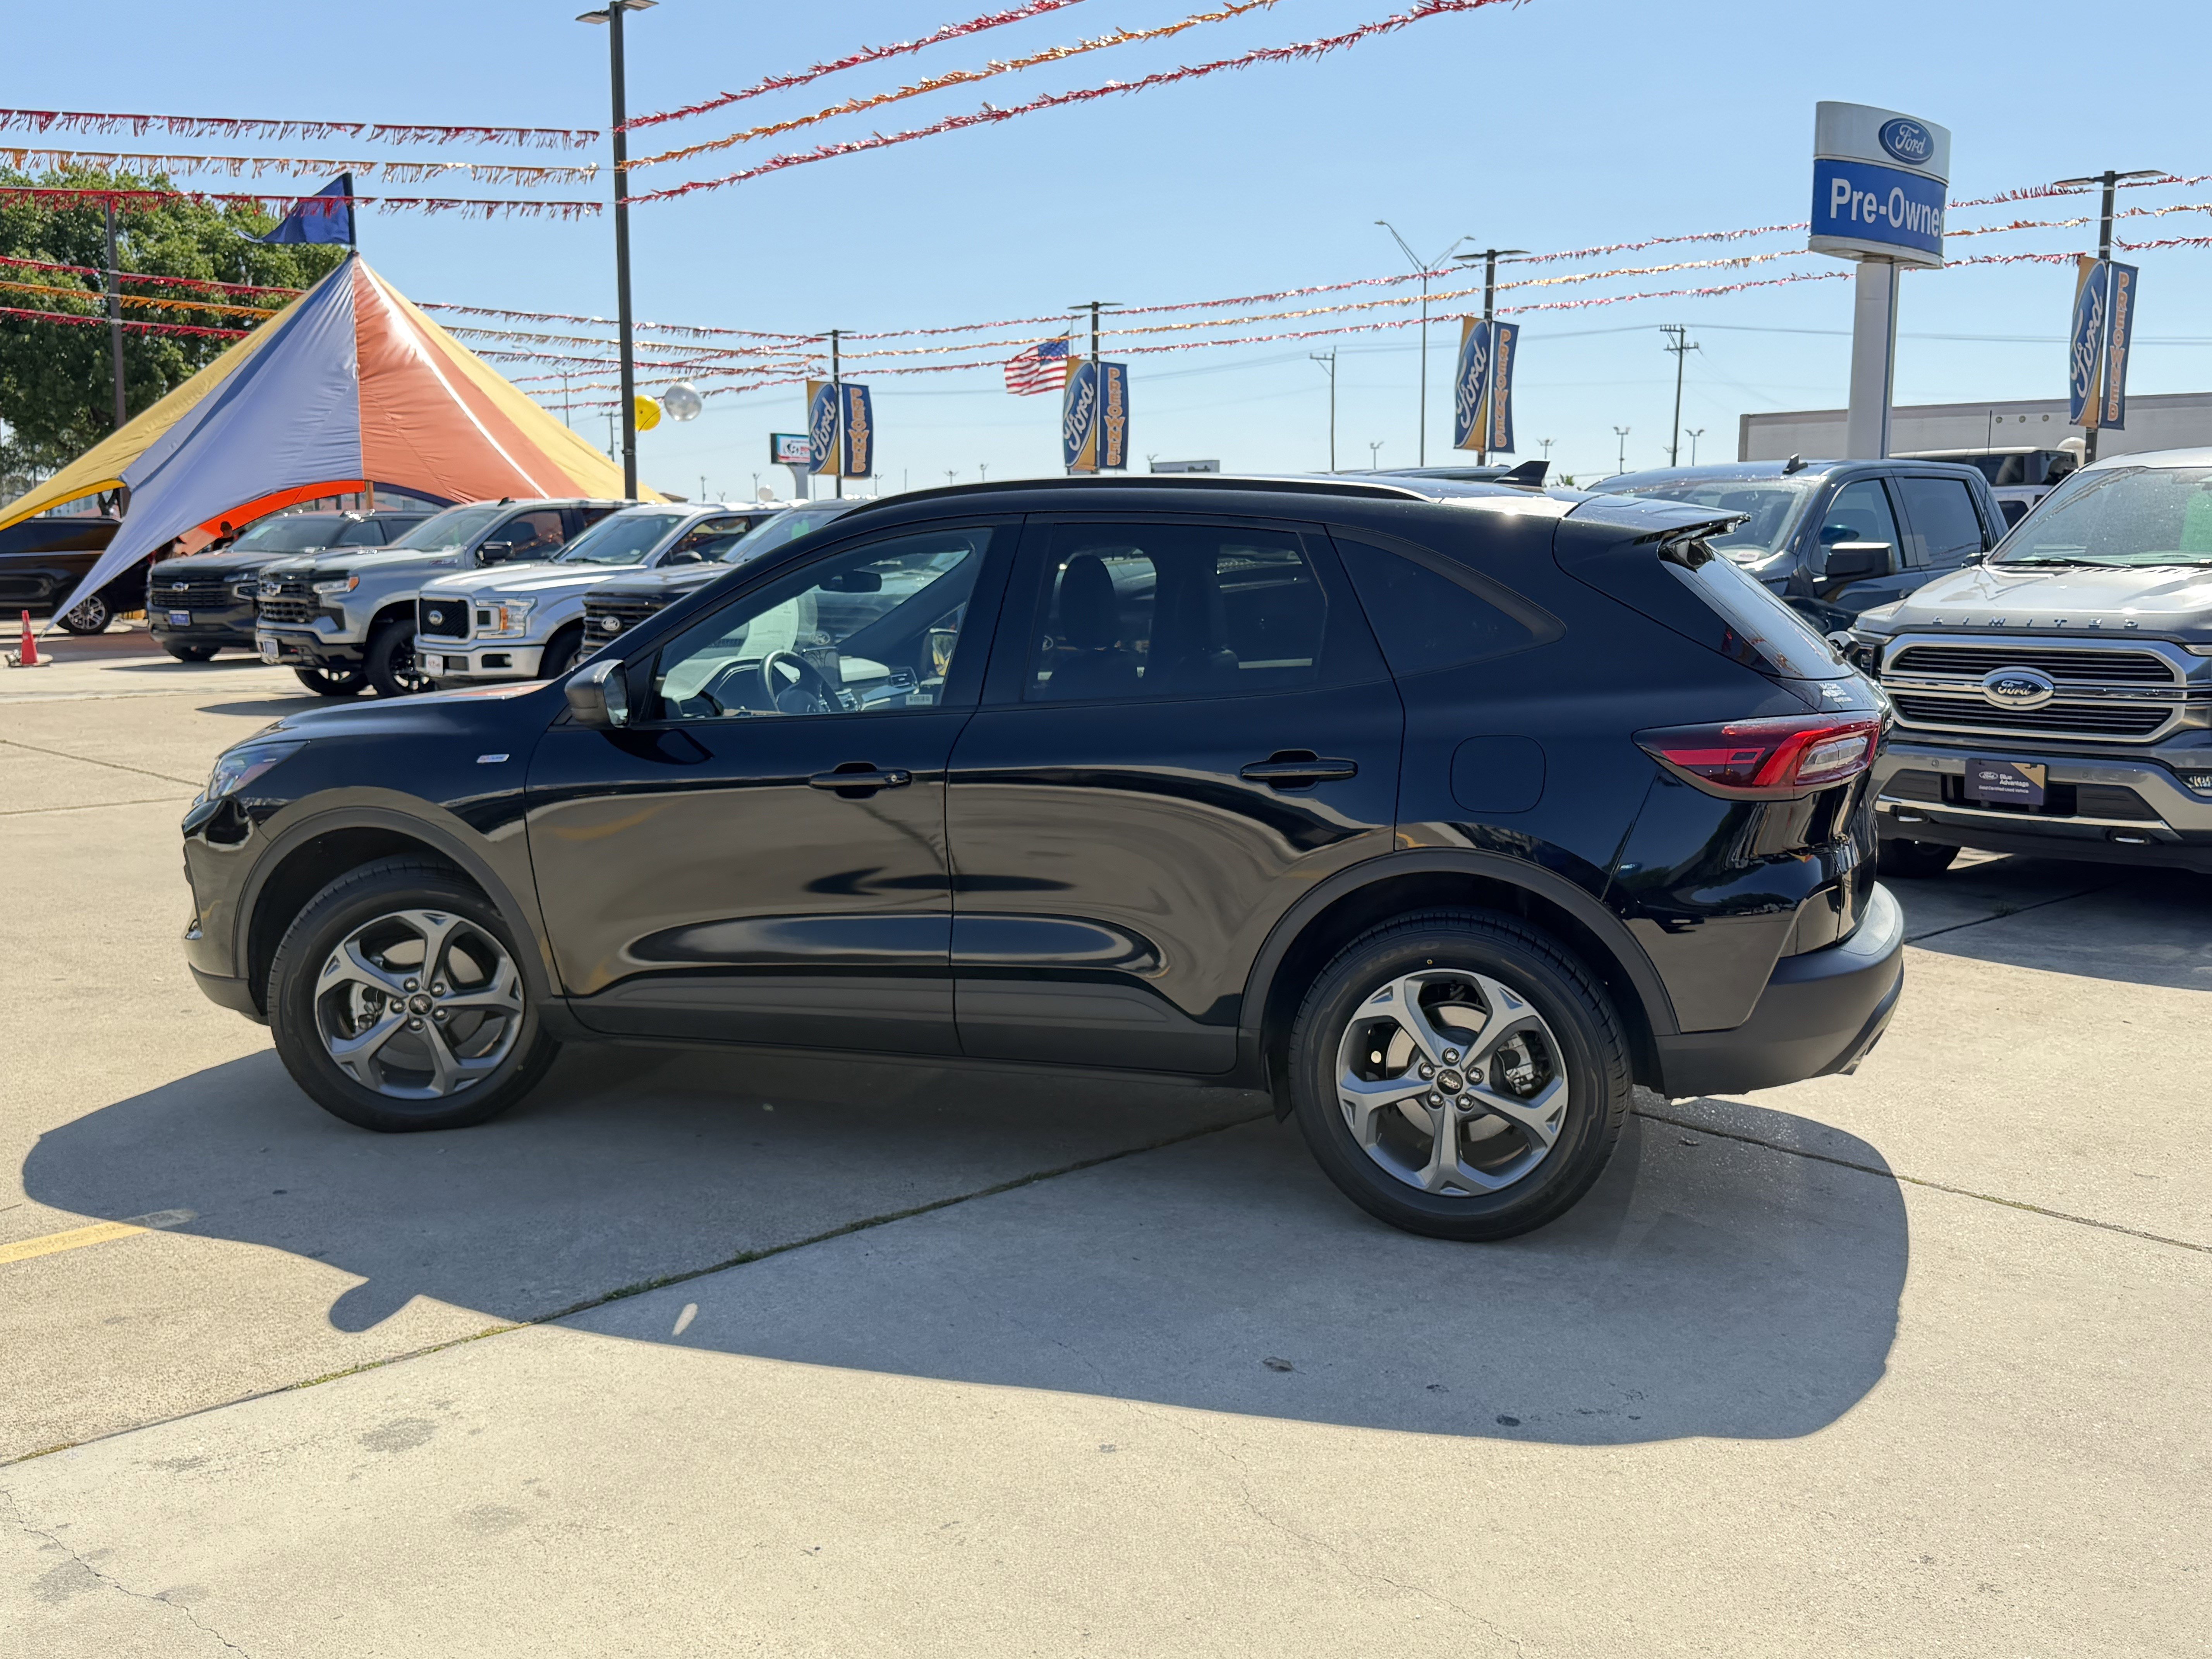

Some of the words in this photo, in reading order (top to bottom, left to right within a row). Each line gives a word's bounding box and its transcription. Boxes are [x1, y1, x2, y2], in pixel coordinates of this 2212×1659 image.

[1895, 124, 1926, 154] Ford
[2070, 286, 2103, 398] Ford
[1063, 378, 1094, 451] Ford
[1456, 340, 1487, 429] Ford
[809, 397, 836, 461] Ford
[1998, 680, 2032, 696] Ford
